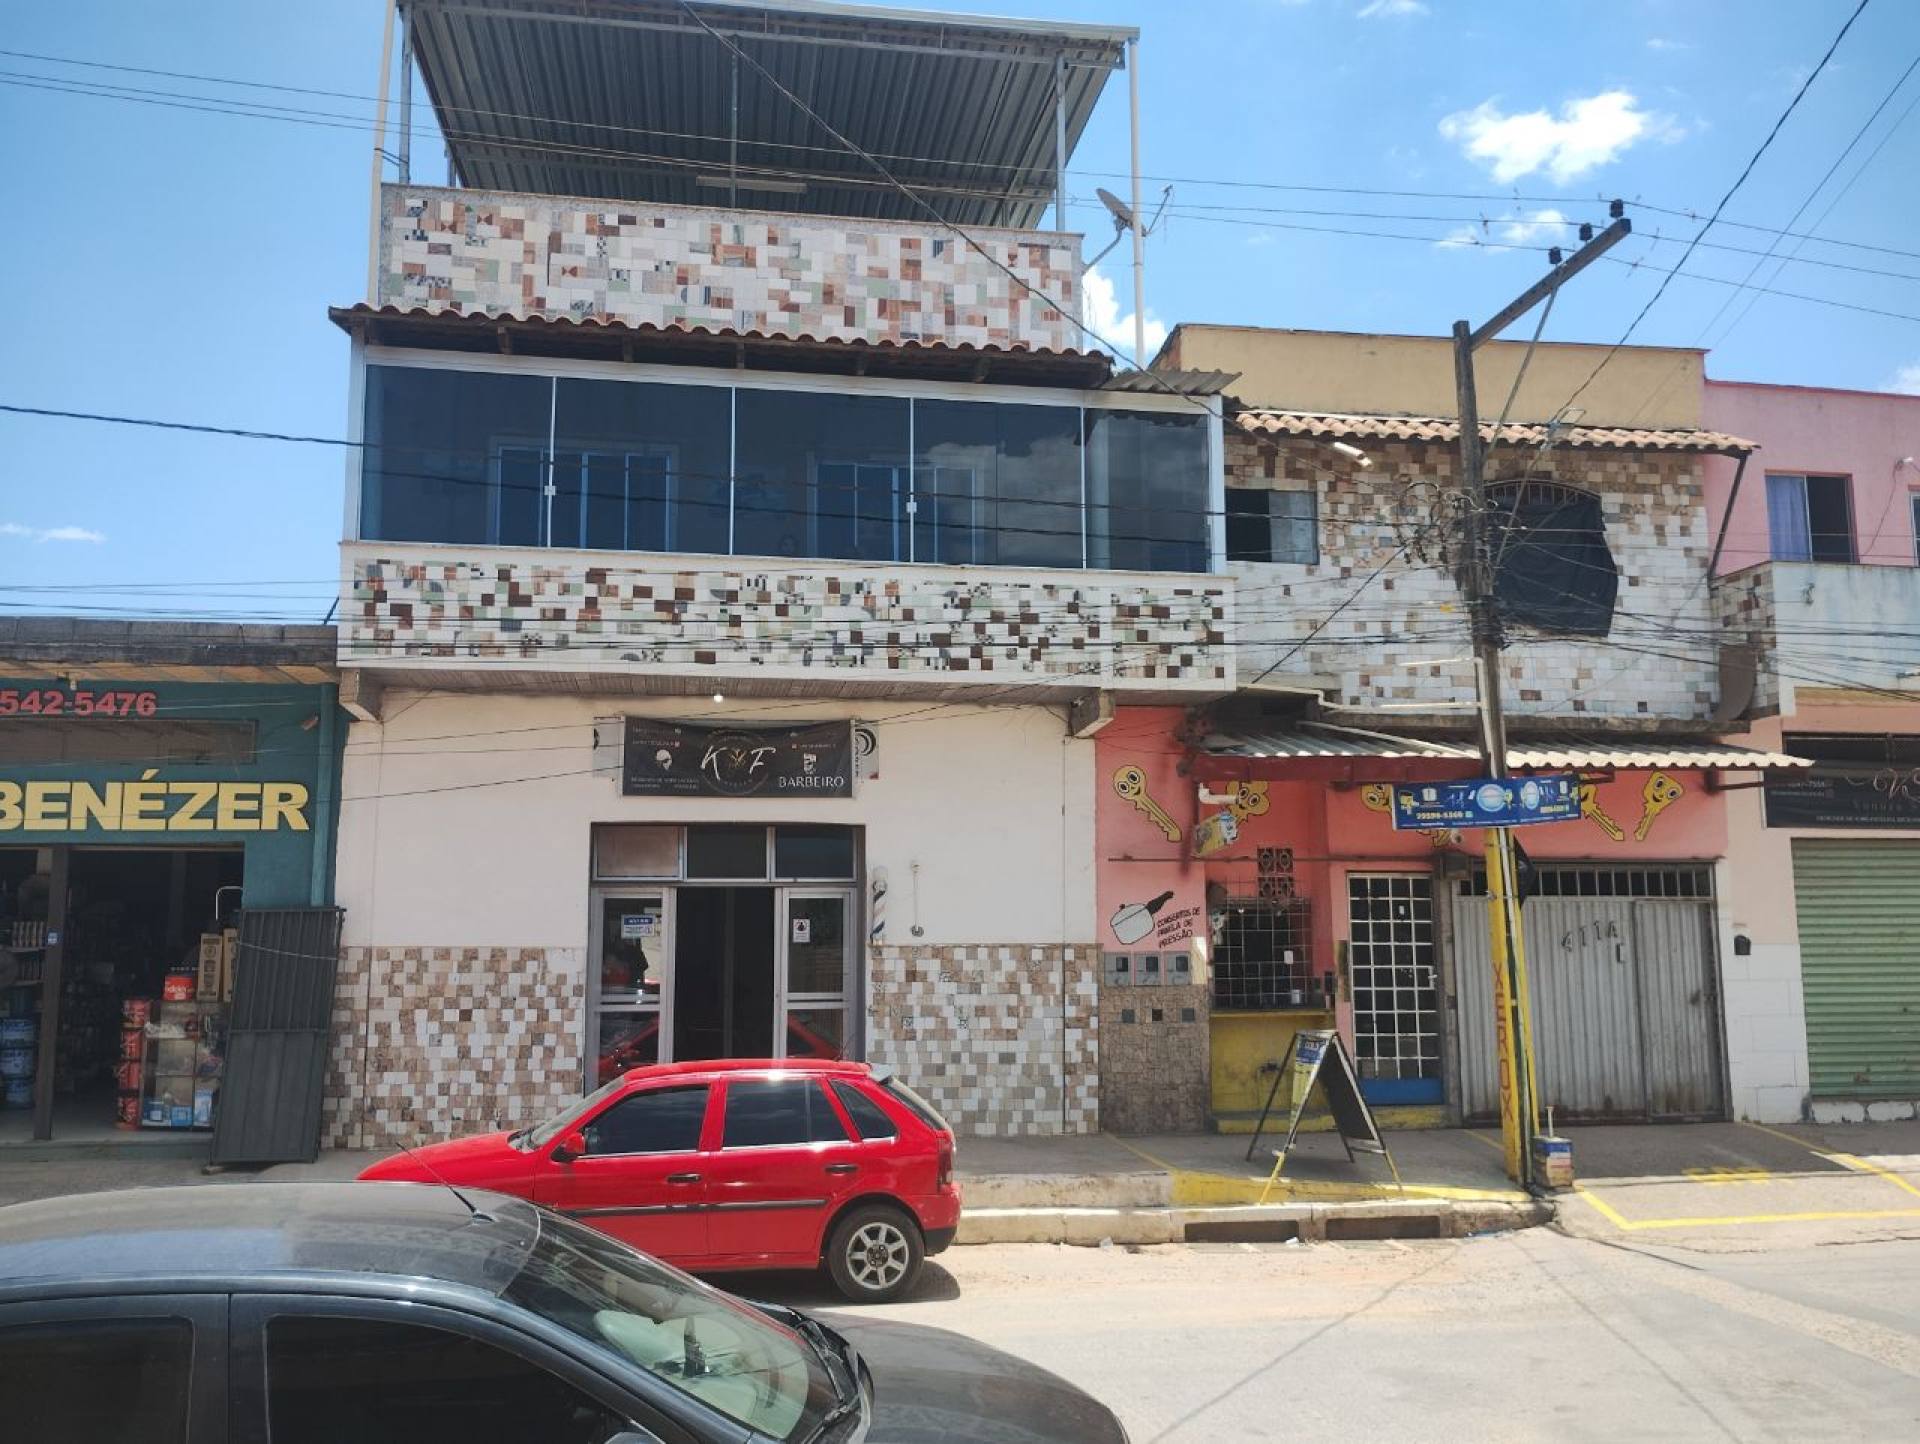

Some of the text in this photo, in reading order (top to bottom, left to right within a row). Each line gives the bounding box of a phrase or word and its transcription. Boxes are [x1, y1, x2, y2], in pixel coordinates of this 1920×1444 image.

[779, 776, 844, 788] BARBEIRO
[1192, 906, 1201, 916] DE
[1159, 928, 1193, 948] PRESSÃO
[1491, 962, 1514, 1123] XEROX
